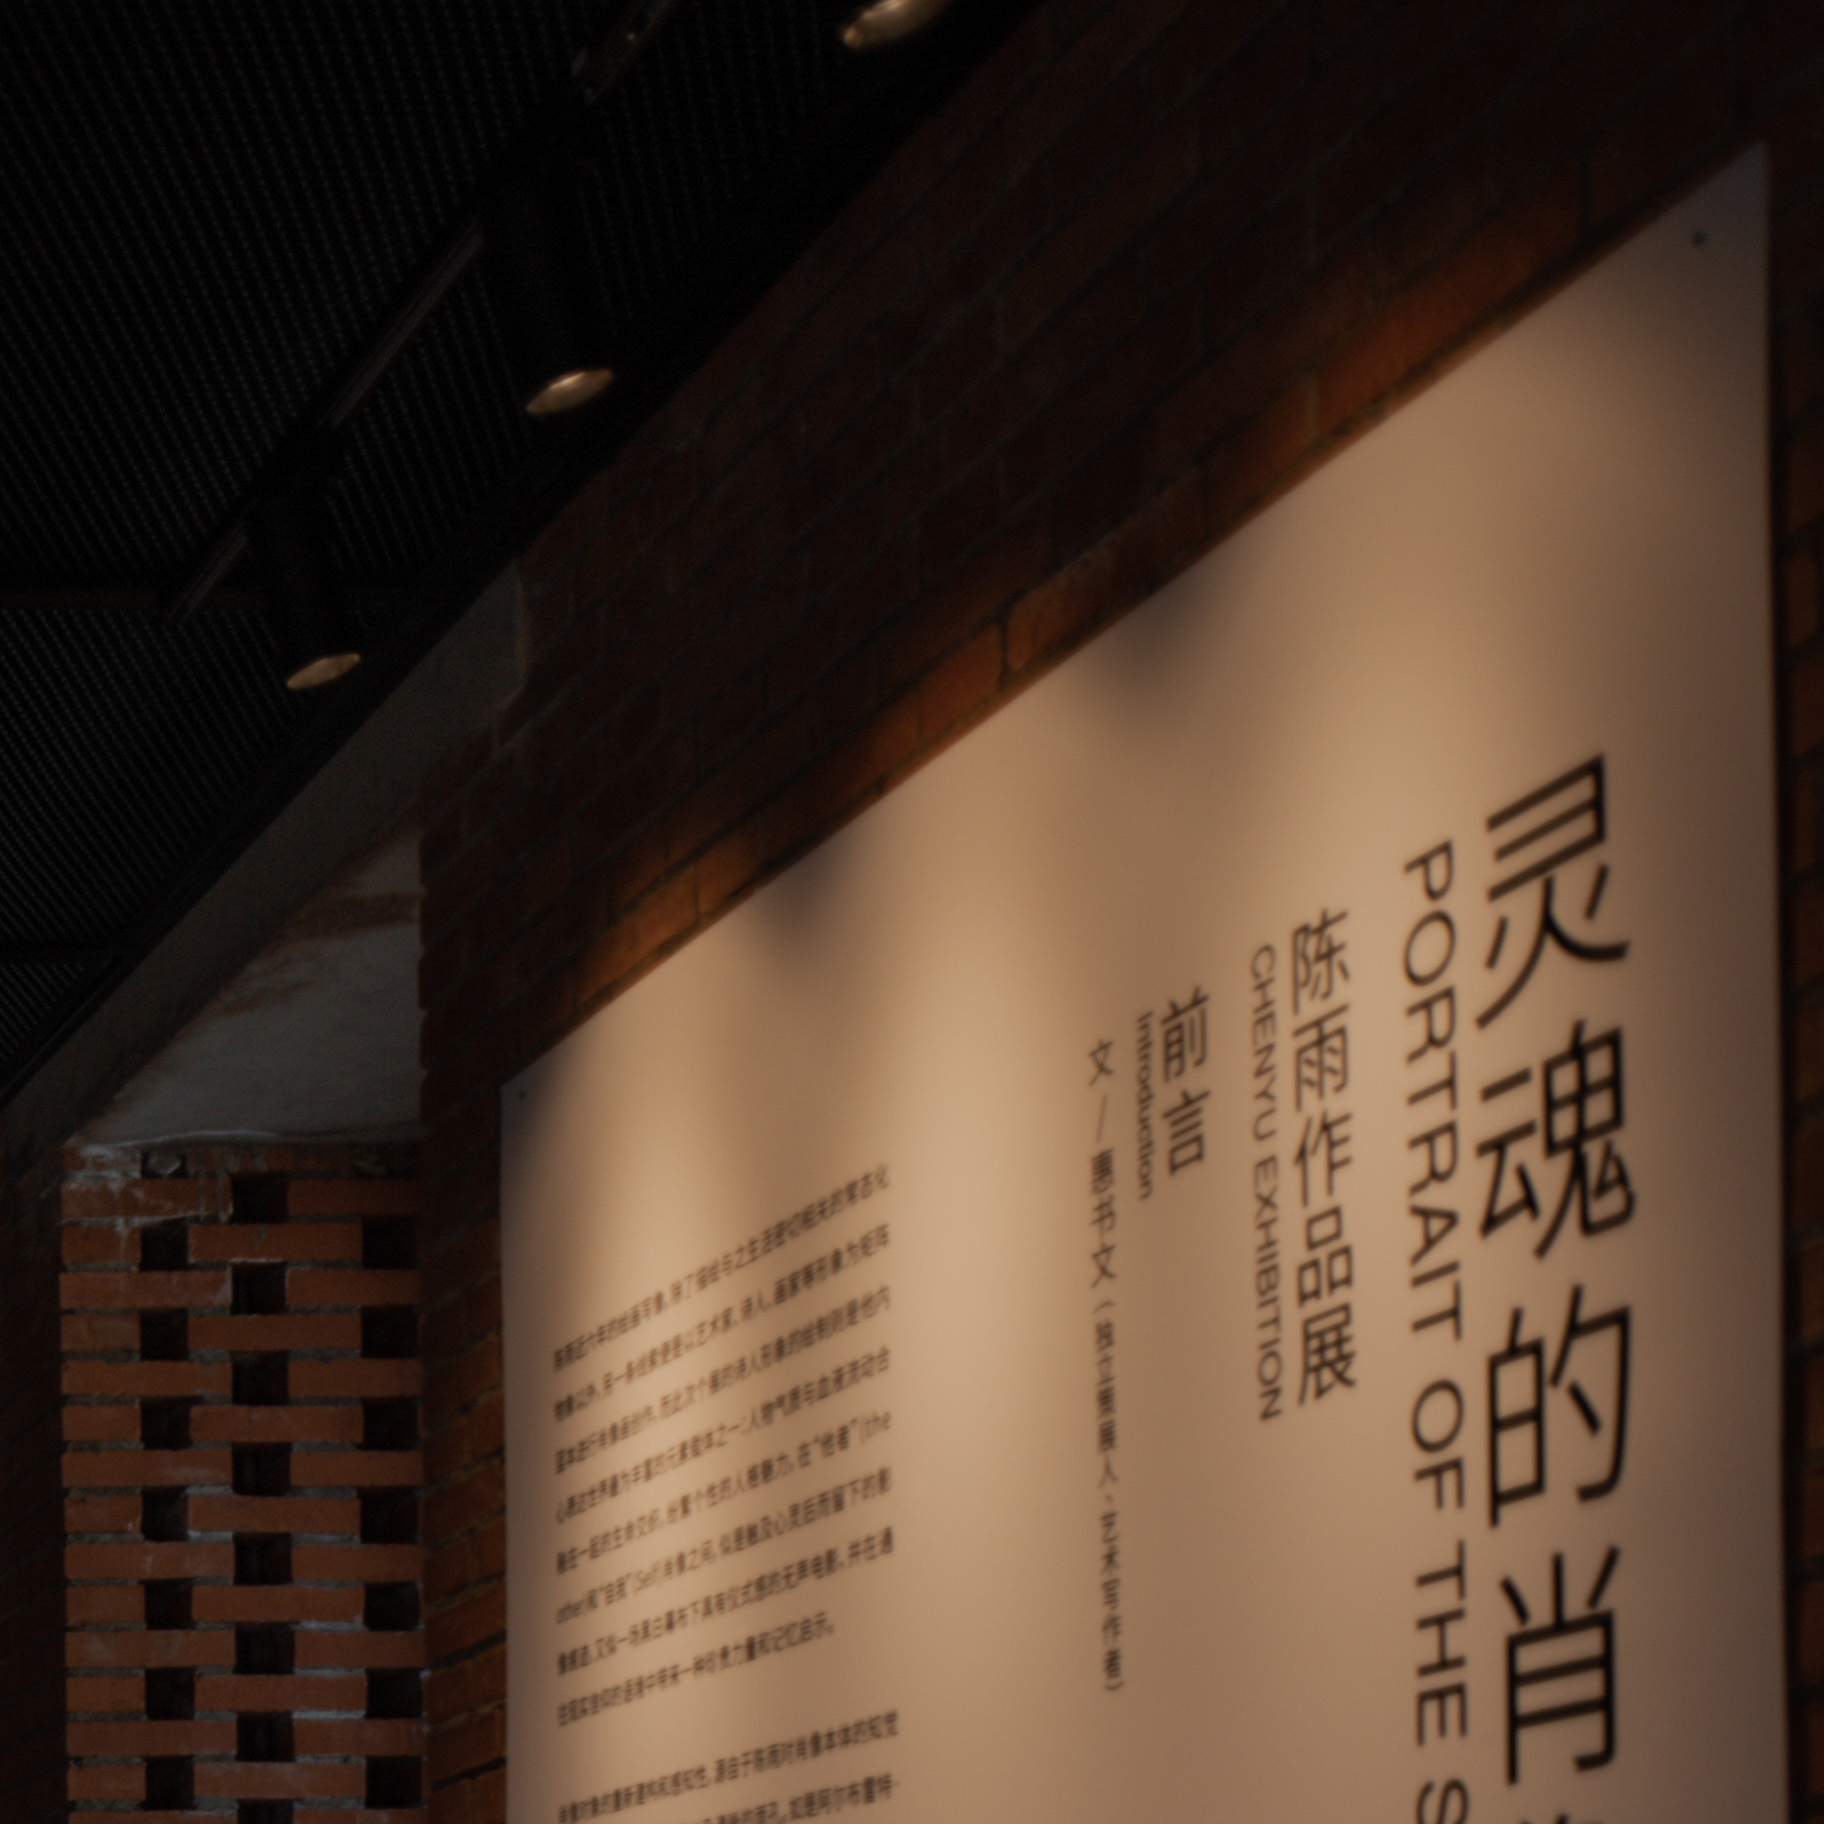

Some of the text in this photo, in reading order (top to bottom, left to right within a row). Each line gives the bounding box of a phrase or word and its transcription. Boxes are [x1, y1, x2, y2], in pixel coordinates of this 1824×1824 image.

[1136, 1011, 1156, 1202] Introduction
[1160, 985, 1212, 1179] 前言
[1250, 943, 1284, 1424] CHENYU EXHIBITION
[1291, 908, 1357, 1407] 陈雨作品展
[1402, 839, 1464, 1342] PORTRAIT
[1410, 1378, 1466, 1512] OF
[1414, 1540, 1470, 1749] THE
